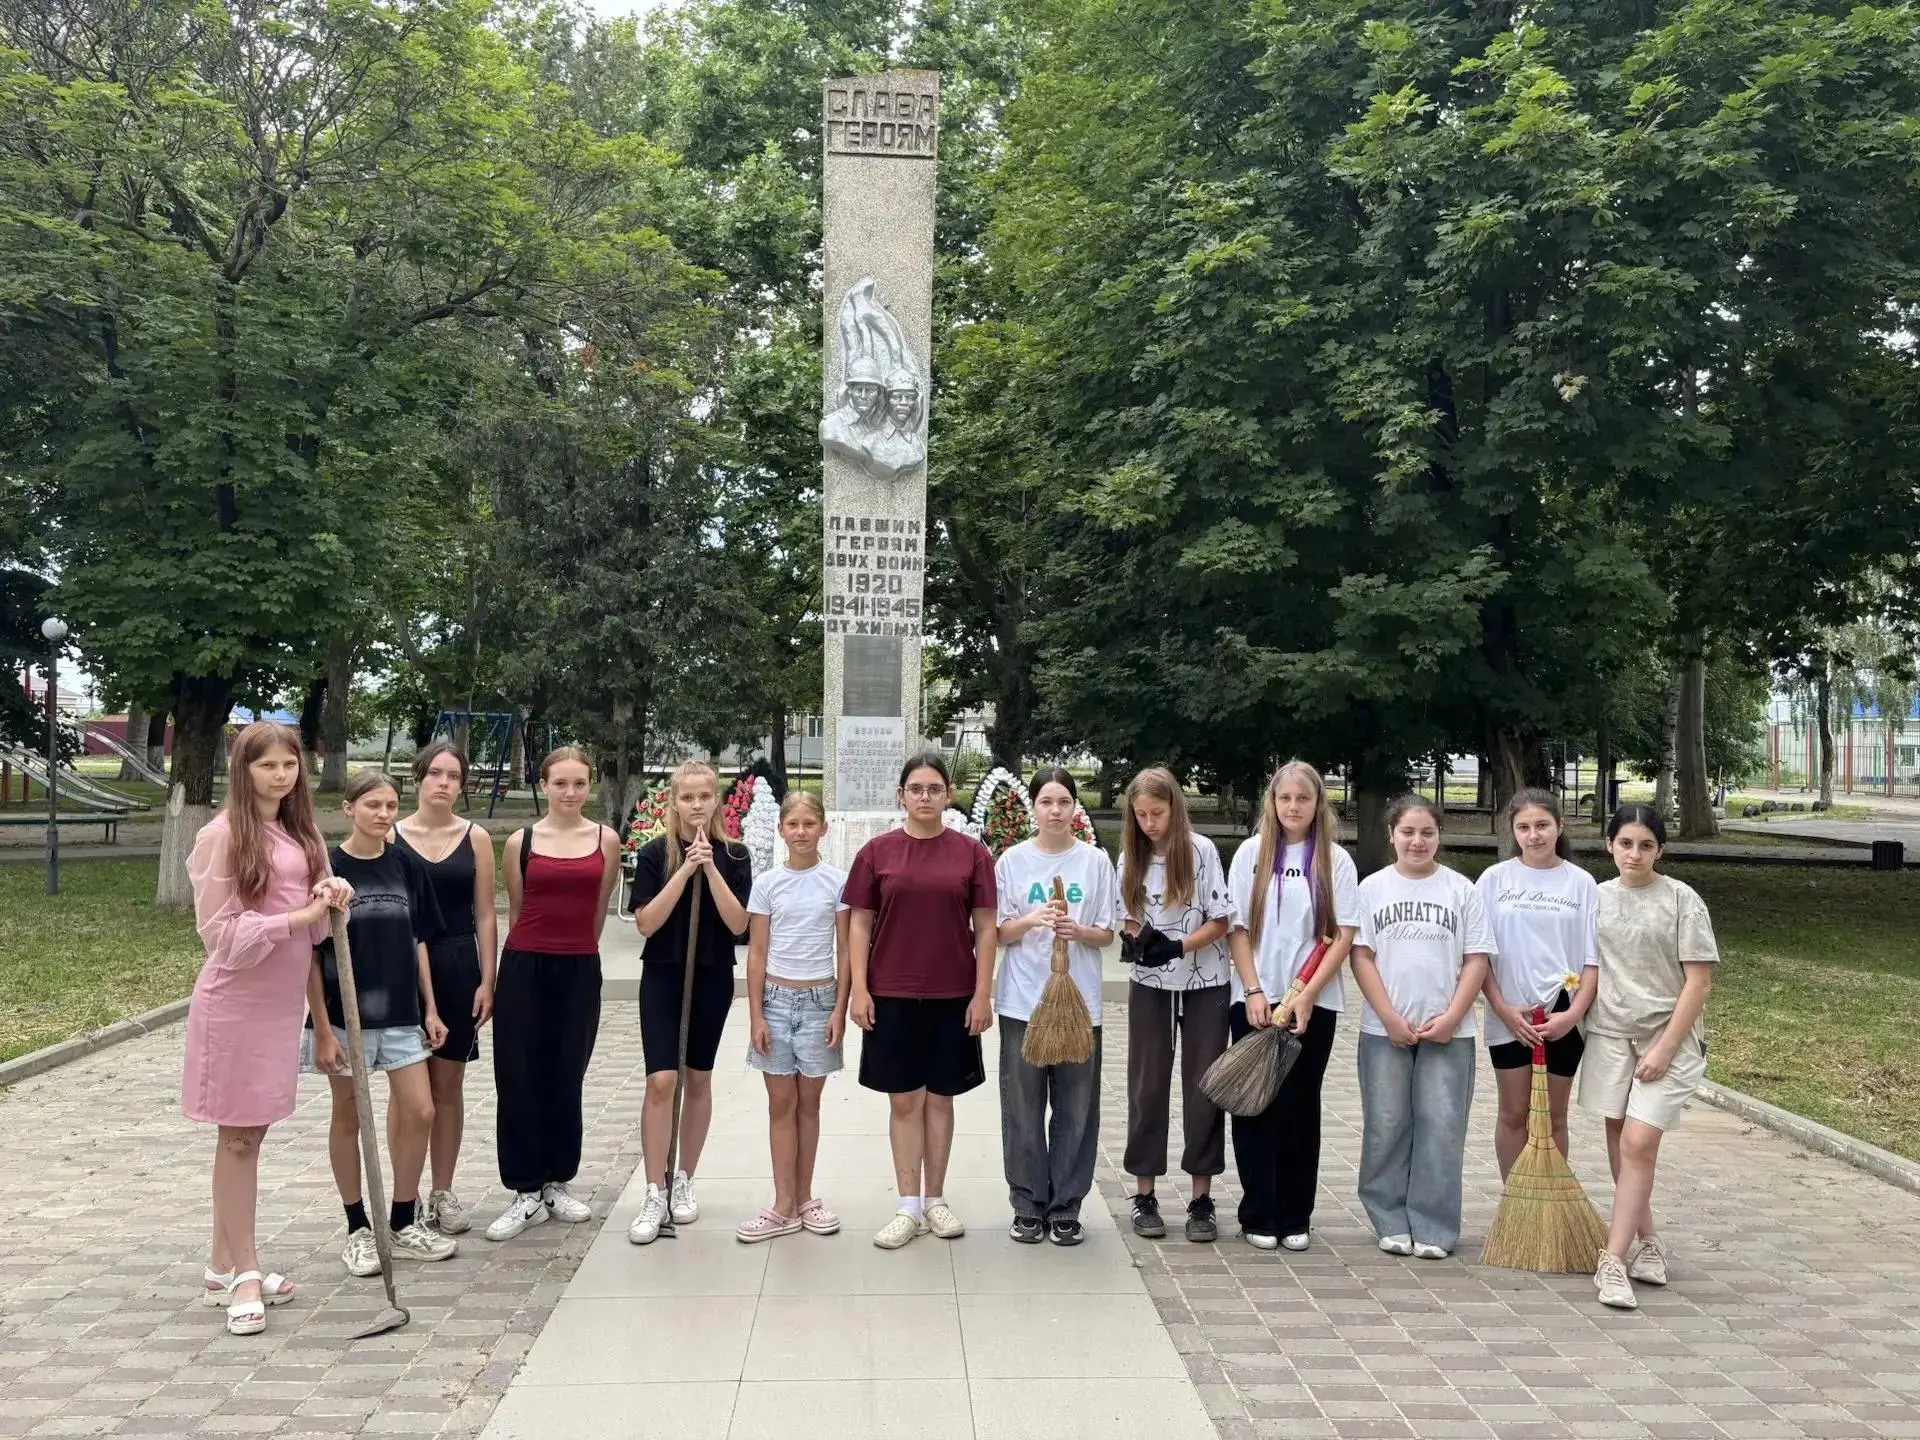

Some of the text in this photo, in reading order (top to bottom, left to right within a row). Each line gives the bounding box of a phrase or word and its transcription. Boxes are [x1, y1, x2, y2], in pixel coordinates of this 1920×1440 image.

[828, 90, 935, 120] СЛАВА
[828, 121, 935, 150] ГЕРОЯМ
[829, 517, 920, 534] ПАВШИМ
[836, 535, 917, 552] ГЕРОЯМ
[825, 553, 868, 568] ДВУХ
[848, 573, 902, 594] 1920
[1373, 901, 1458, 936] MANHATTAN
